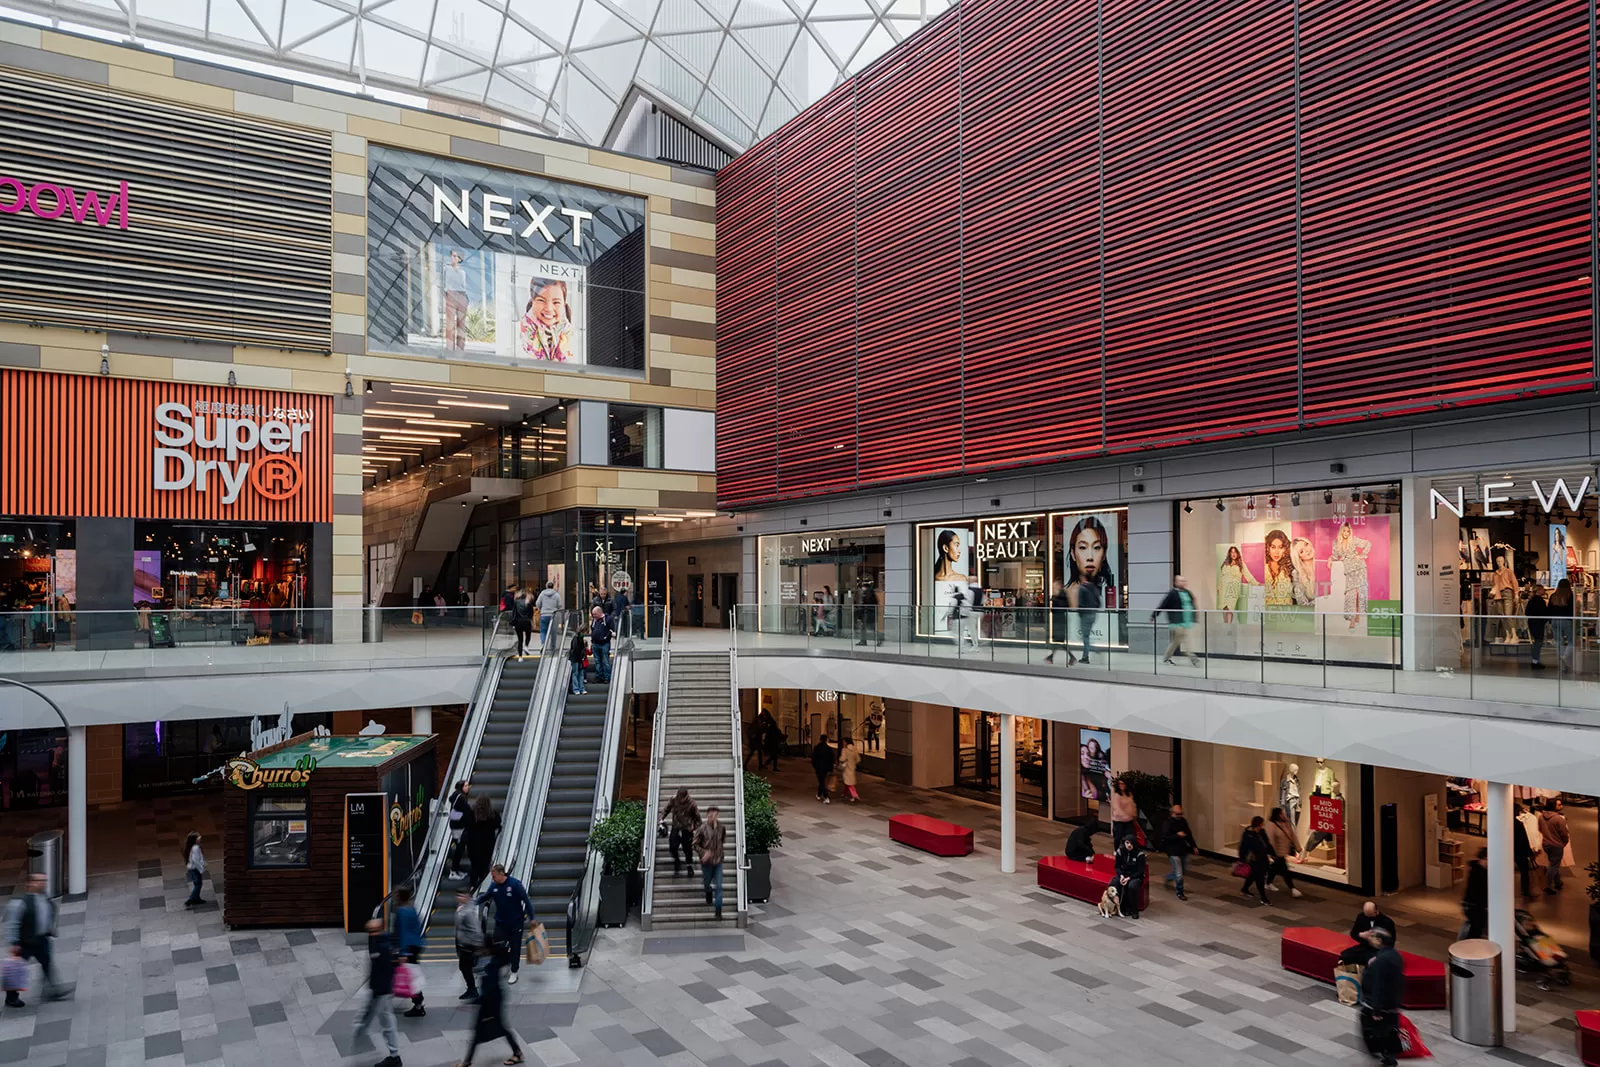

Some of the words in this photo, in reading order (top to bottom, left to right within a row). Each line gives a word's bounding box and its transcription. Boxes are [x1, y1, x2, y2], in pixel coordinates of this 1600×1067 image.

[433, 184, 592, 247] NEXT
[540, 264, 579, 278] NEXT
[154, 402, 311, 461] Super
[1430, 476, 1591, 520] NEW
[984, 521, 1032, 540] NEXT
[802, 538, 831, 553] NEXT
[976, 540, 1041, 560] BEAUTY
[1312, 804, 1339, 814] SEASON
[1319, 799, 1333, 807] MID
[1318, 811, 1333, 820] SALE
[1317, 821, 1336, 831] 50%
